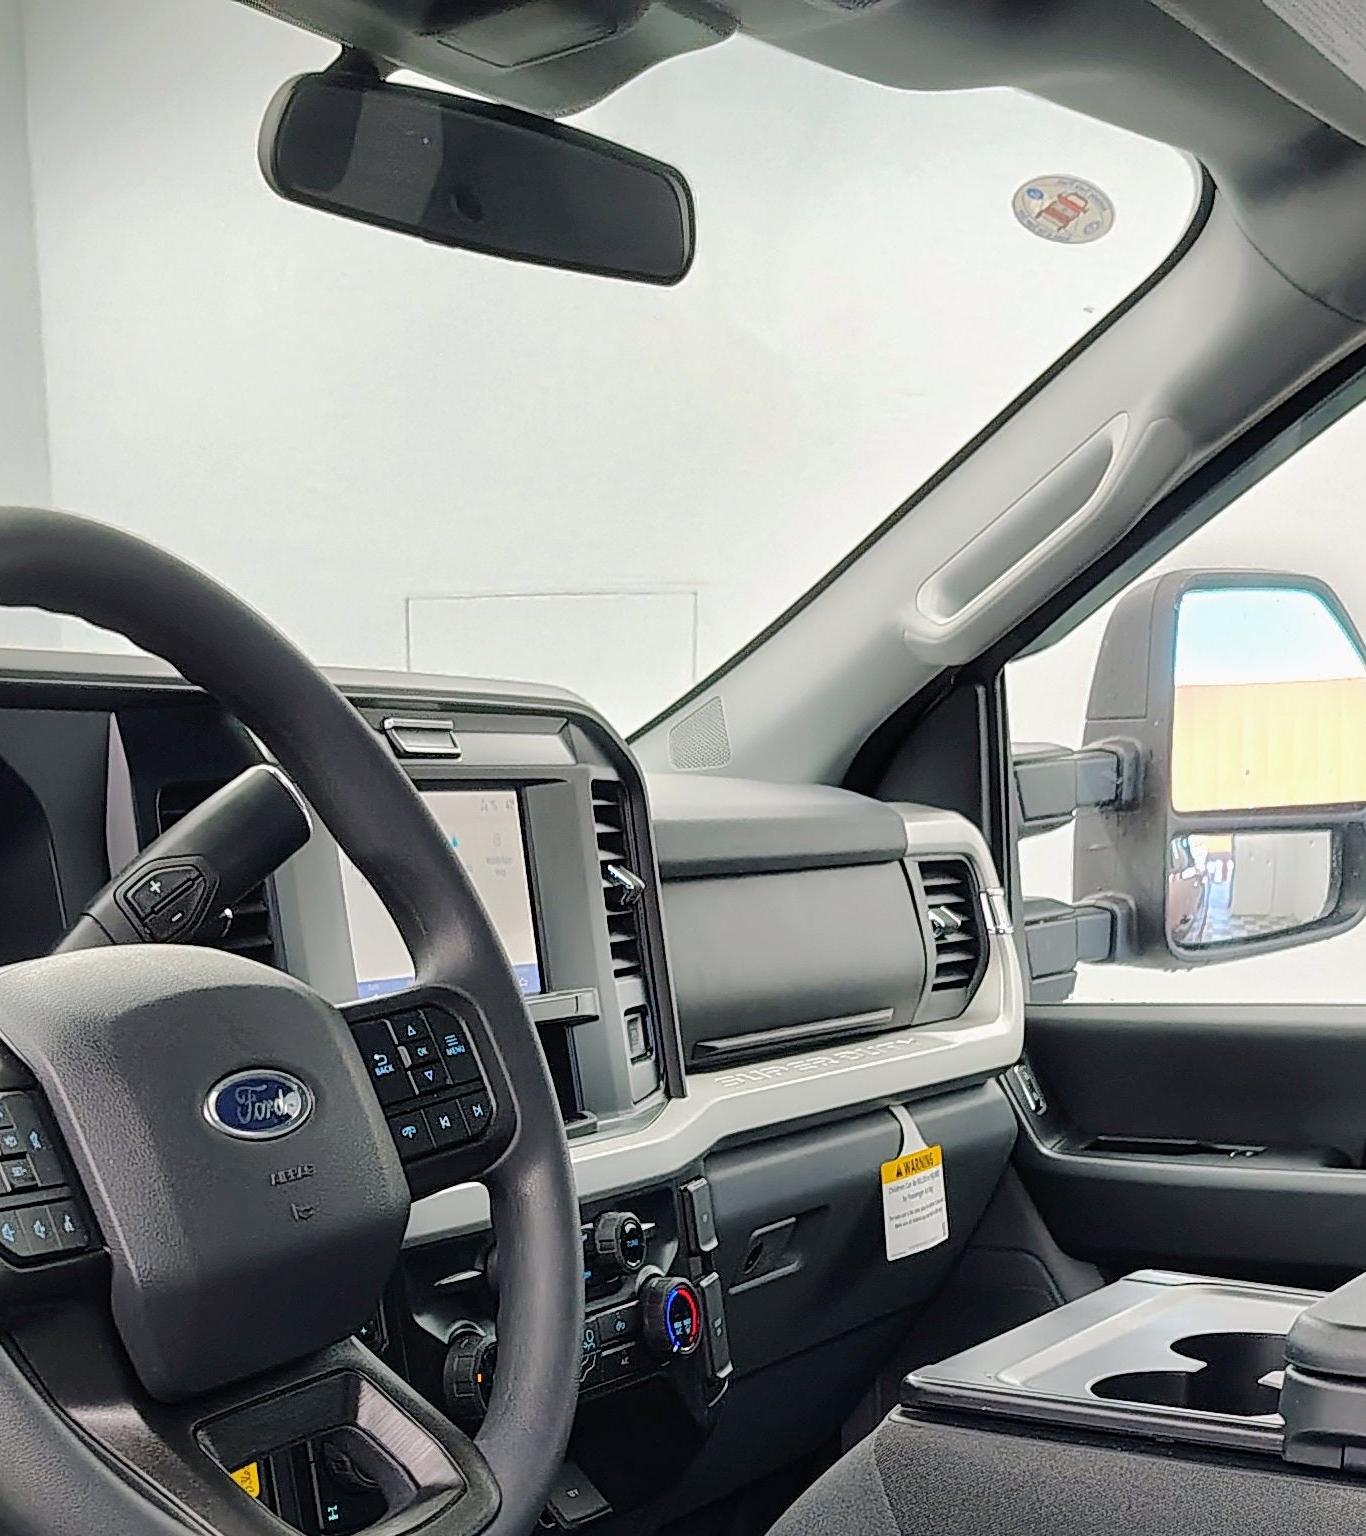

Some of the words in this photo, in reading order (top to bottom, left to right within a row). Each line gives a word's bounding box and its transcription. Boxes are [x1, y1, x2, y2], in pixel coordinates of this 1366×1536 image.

[417, 1046, 429, 1057] OK
[375, 1063, 395, 1077] BACK
[903, 1152, 934, 1176] WARNING
